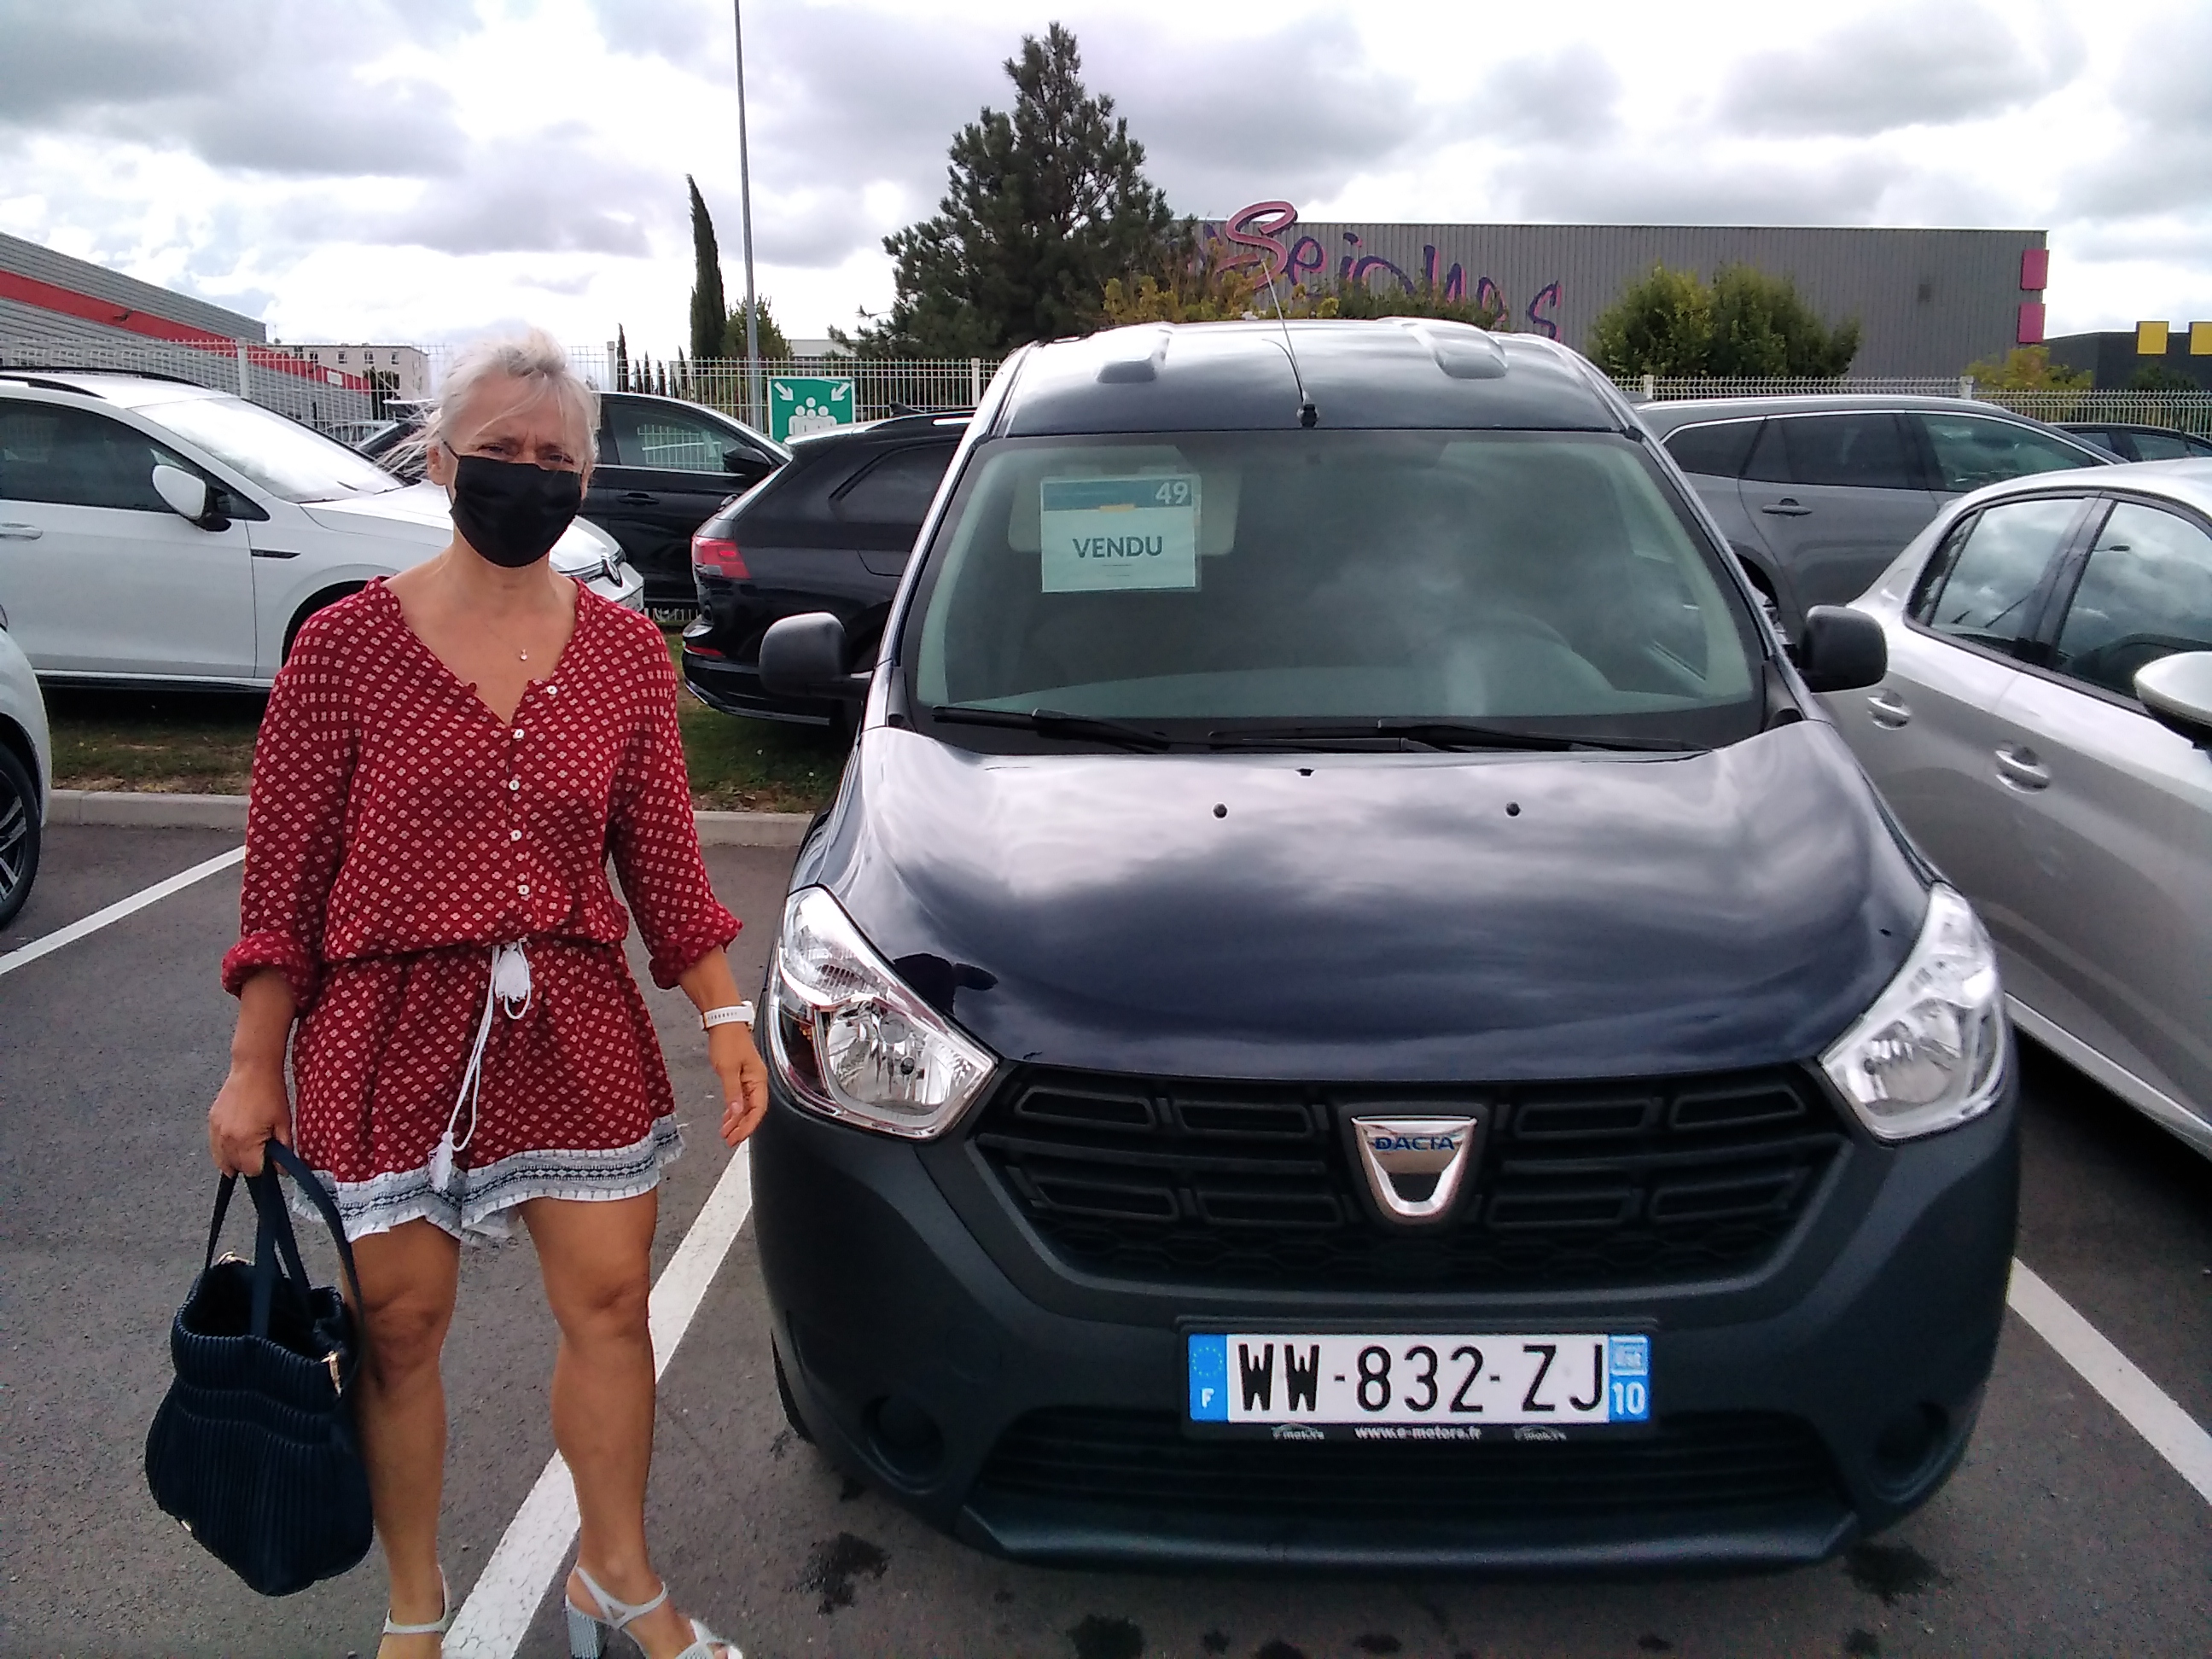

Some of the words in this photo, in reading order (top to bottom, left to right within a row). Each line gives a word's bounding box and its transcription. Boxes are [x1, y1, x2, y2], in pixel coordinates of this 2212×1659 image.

[1155, 481, 1188, 505] 49
[1072, 536, 1163, 559] VENDU
[1374, 1136, 1455, 1151] DACIA
[1201, 1387, 1215, 1409] F
[1612, 1381, 1646, 1415] 10
